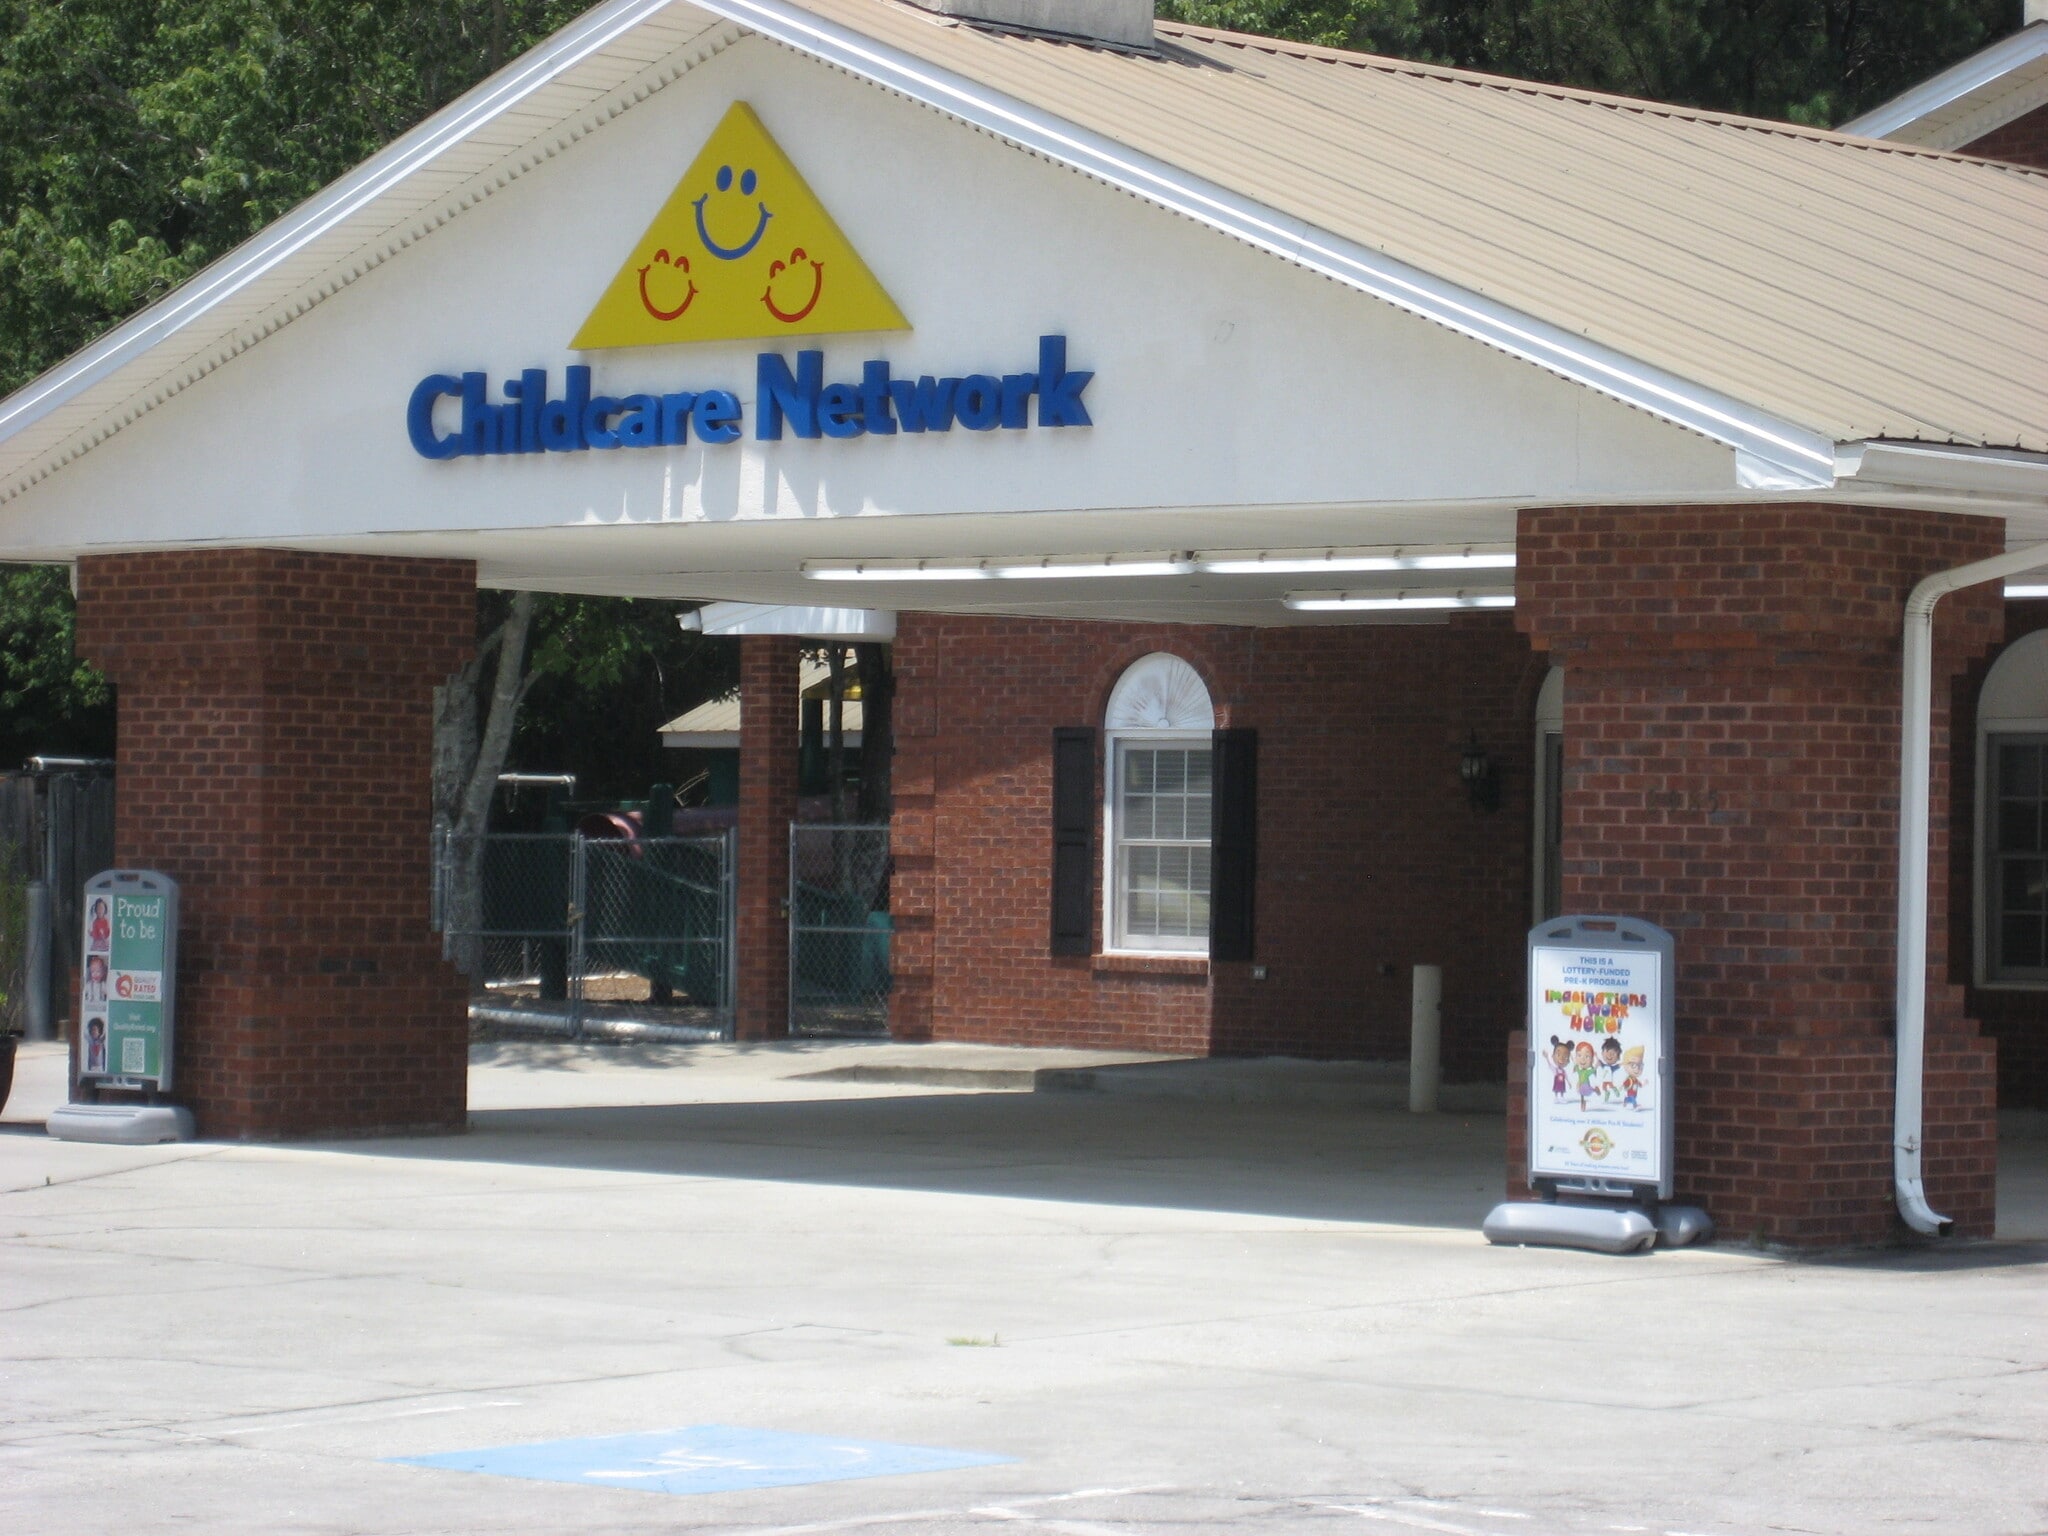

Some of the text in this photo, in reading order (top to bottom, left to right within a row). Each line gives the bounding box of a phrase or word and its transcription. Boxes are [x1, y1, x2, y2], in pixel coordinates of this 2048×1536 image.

[407, 335, 1094, 460] Childcare Network
[117, 897, 161, 918] Proud
[119, 919, 156, 940] to be
[1580, 956, 1614, 966] THIS IS A
[1562, 966, 1631, 977] LOTTERY-FUNDED
[1564, 976, 1629, 987] PRE-K PROGRAM
[134, 984, 157, 993] RATED
